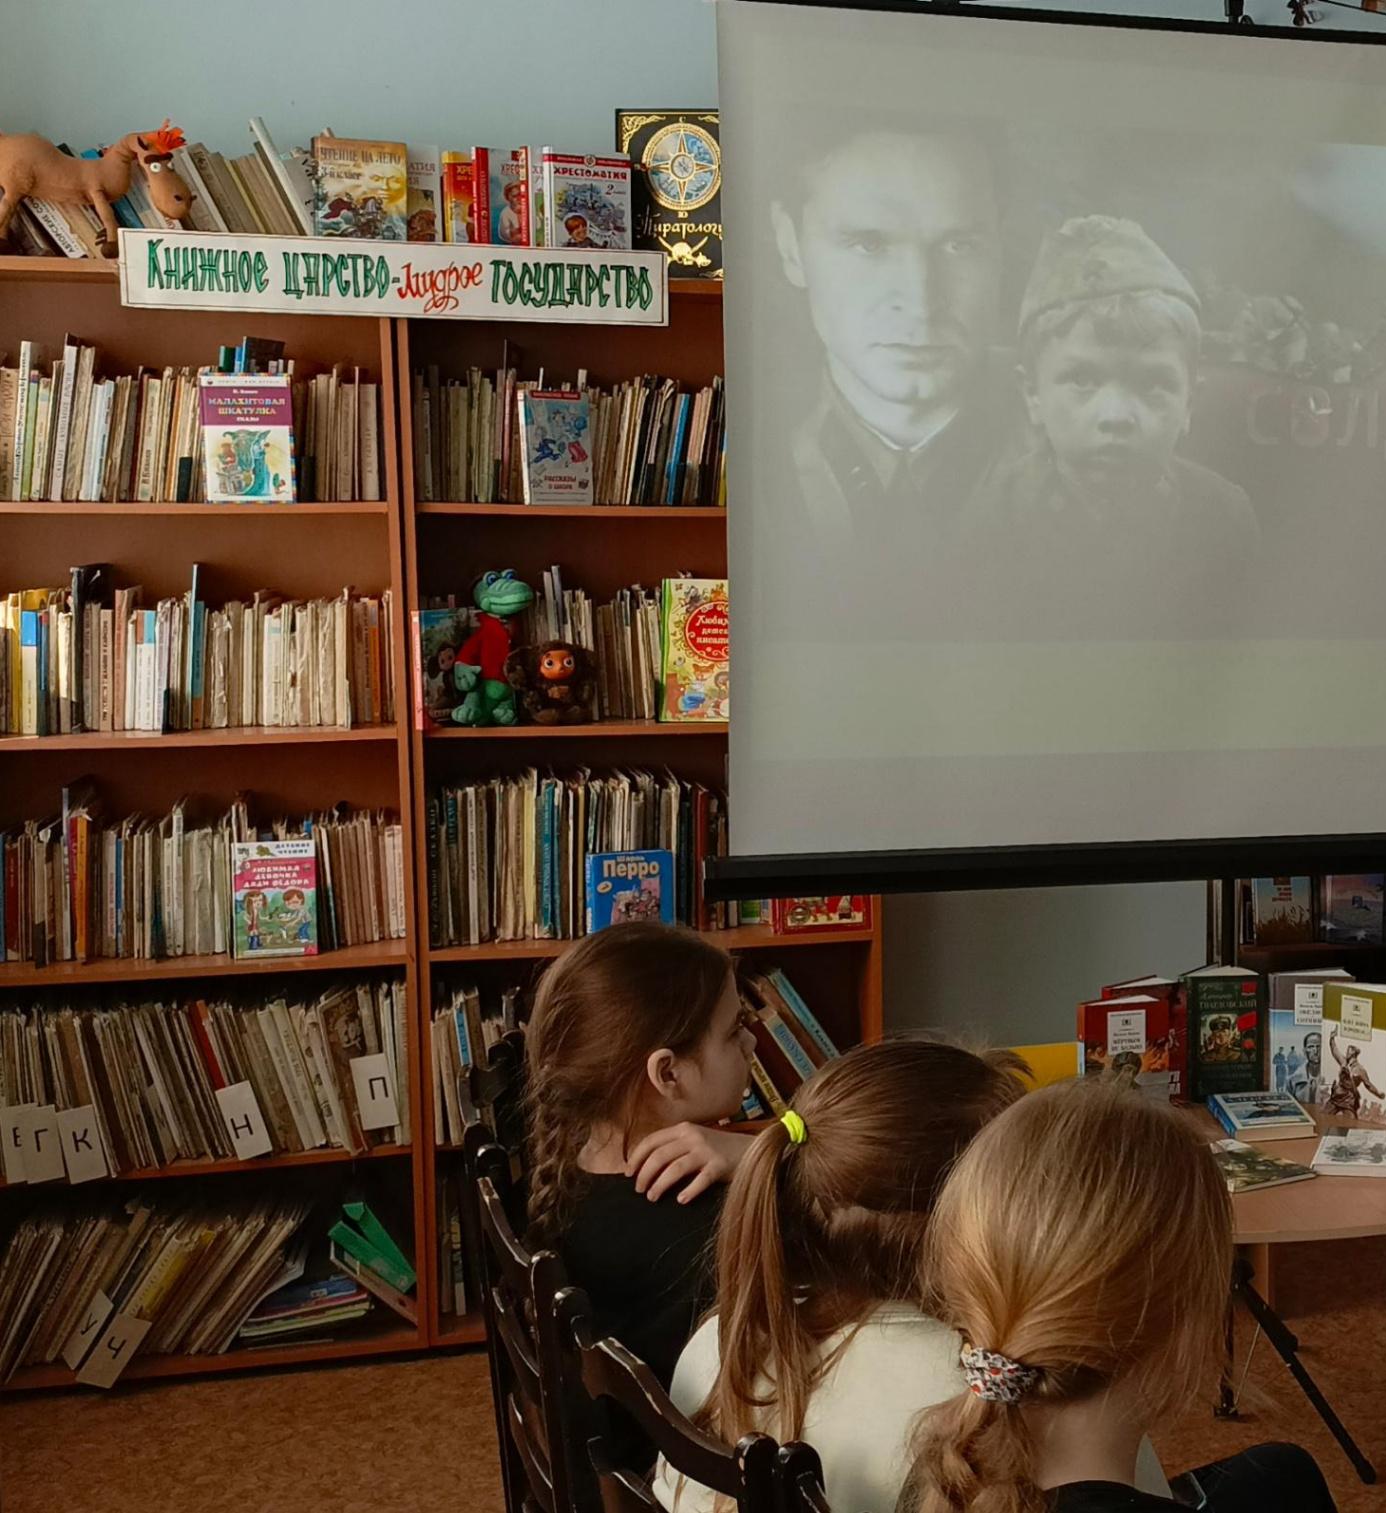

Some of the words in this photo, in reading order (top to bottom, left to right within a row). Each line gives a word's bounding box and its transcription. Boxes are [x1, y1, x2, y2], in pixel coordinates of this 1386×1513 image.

[553, 166, 628, 181] ХРЕСТОМАТИЯ
[605, 183, 614, 196] 2
[489, 259, 654, 312] ГОСУДАРСТВО
[204, 397, 286, 406] МАЛАХИТОВАЯ
[218, 407, 276, 416] ШКАТУЛКА
[429, 808, 438, 858] СКАЗКИ
[252, 865, 300, 874] ЛЮБИМАЯ
[254, 872, 298, 881] ДЕВОЧКА
[603, 859, 660, 880] Перро
[369, 1075, 389, 1101] П
[230, 1113, 253, 1140] Н
[34, 1128, 49, 1152] Г
[72, 1128, 92, 1153] К
[80, 1312, 97, 1336] У
